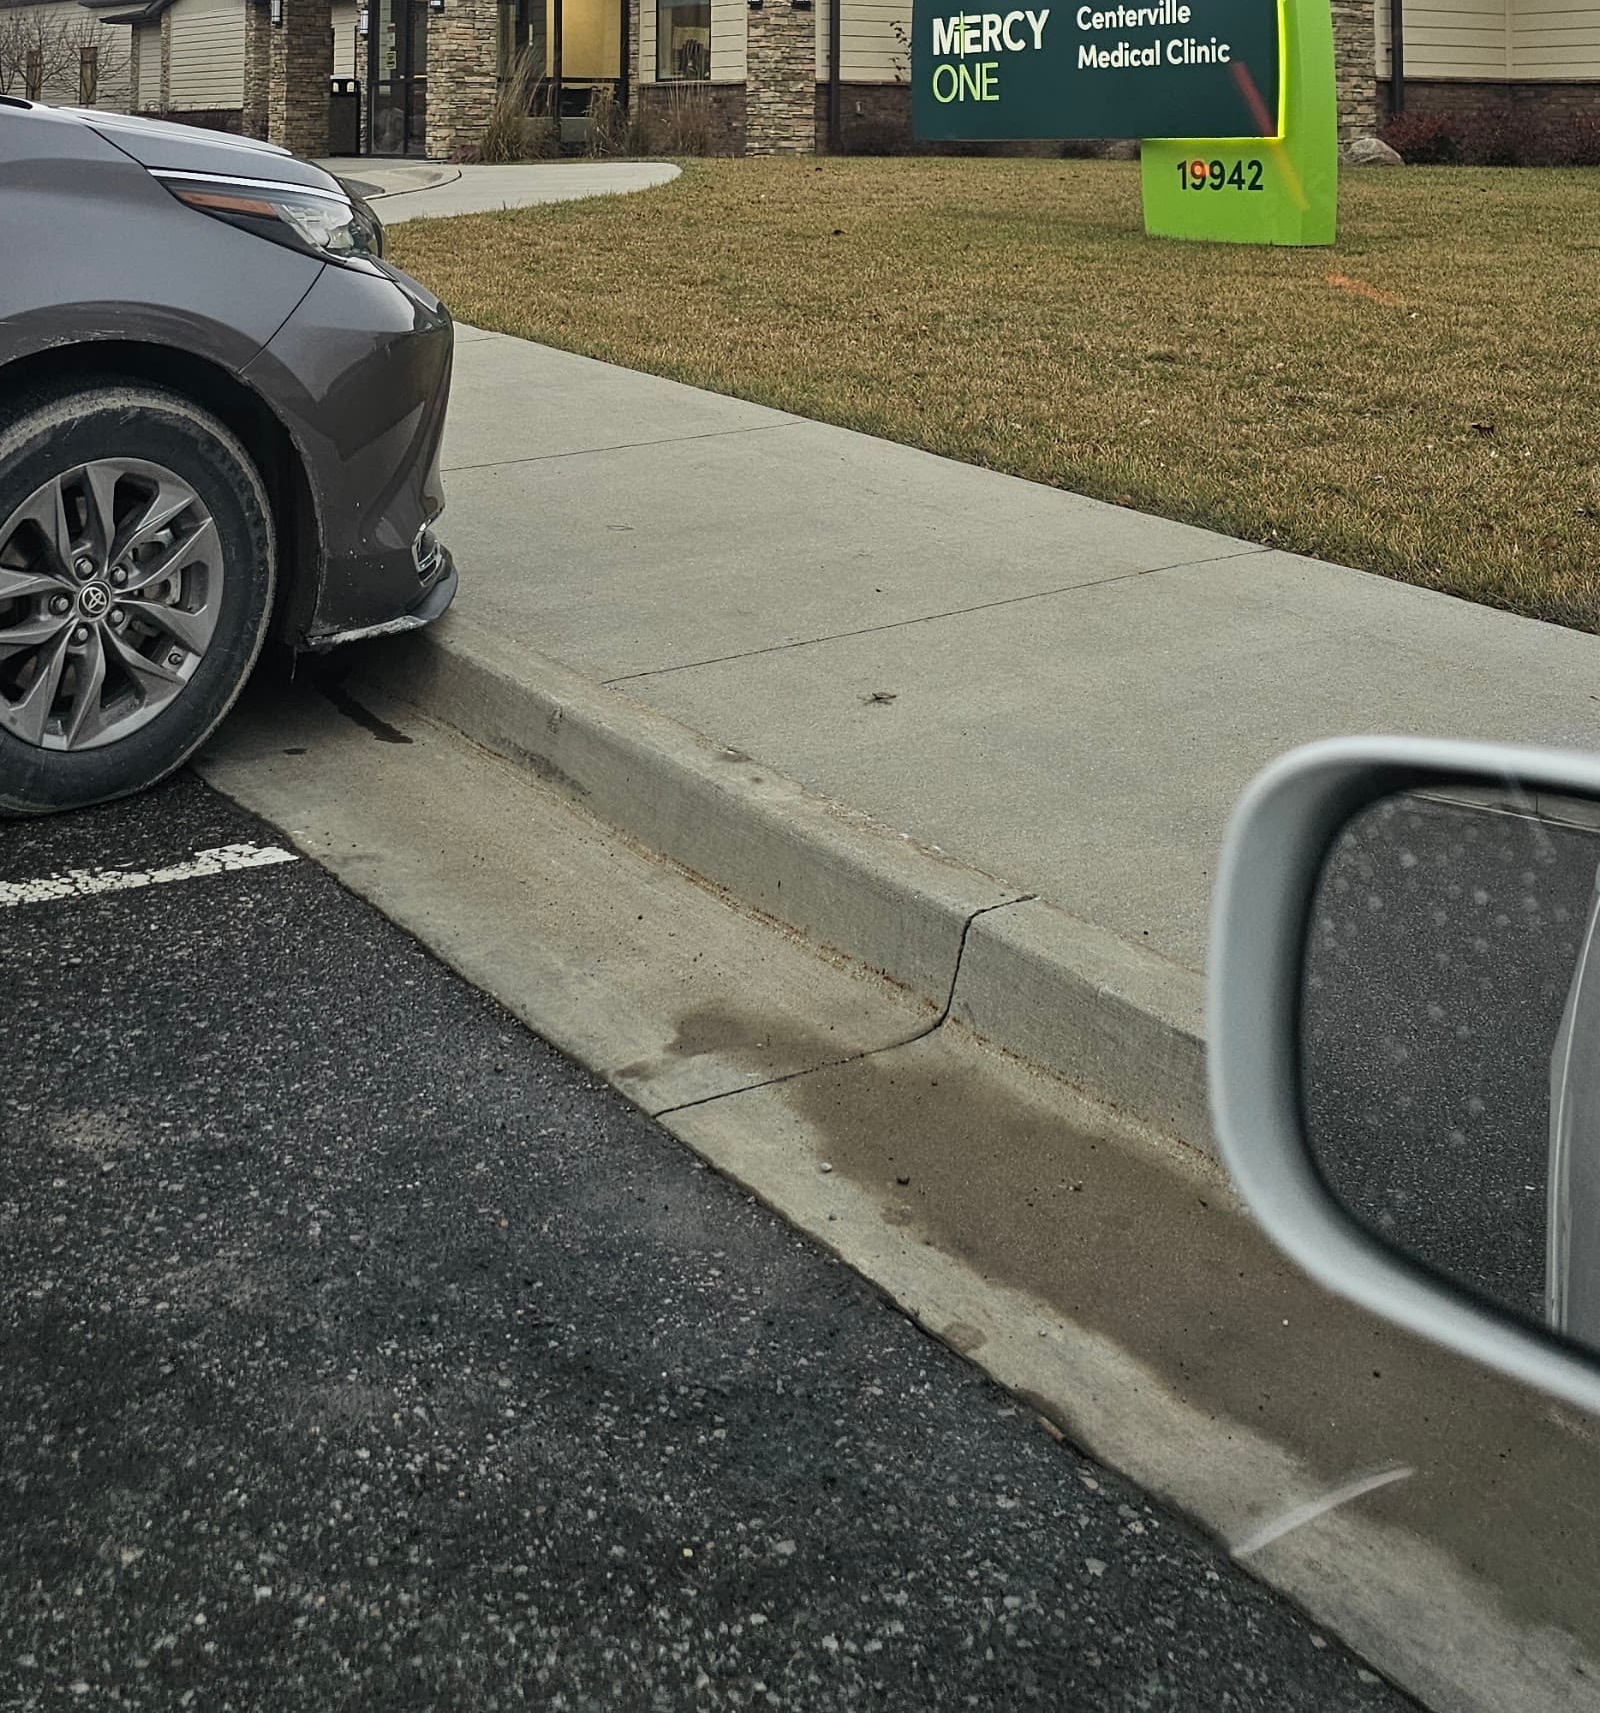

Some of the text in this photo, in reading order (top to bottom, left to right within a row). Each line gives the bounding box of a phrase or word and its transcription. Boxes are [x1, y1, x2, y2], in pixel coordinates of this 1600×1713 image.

[932, 9, 1049, 59] MERCY
[1078, 37, 1230, 69] Medical Clinic
[932, 62, 1000, 103] ONE
[1177, 160, 1263, 191] 19942
